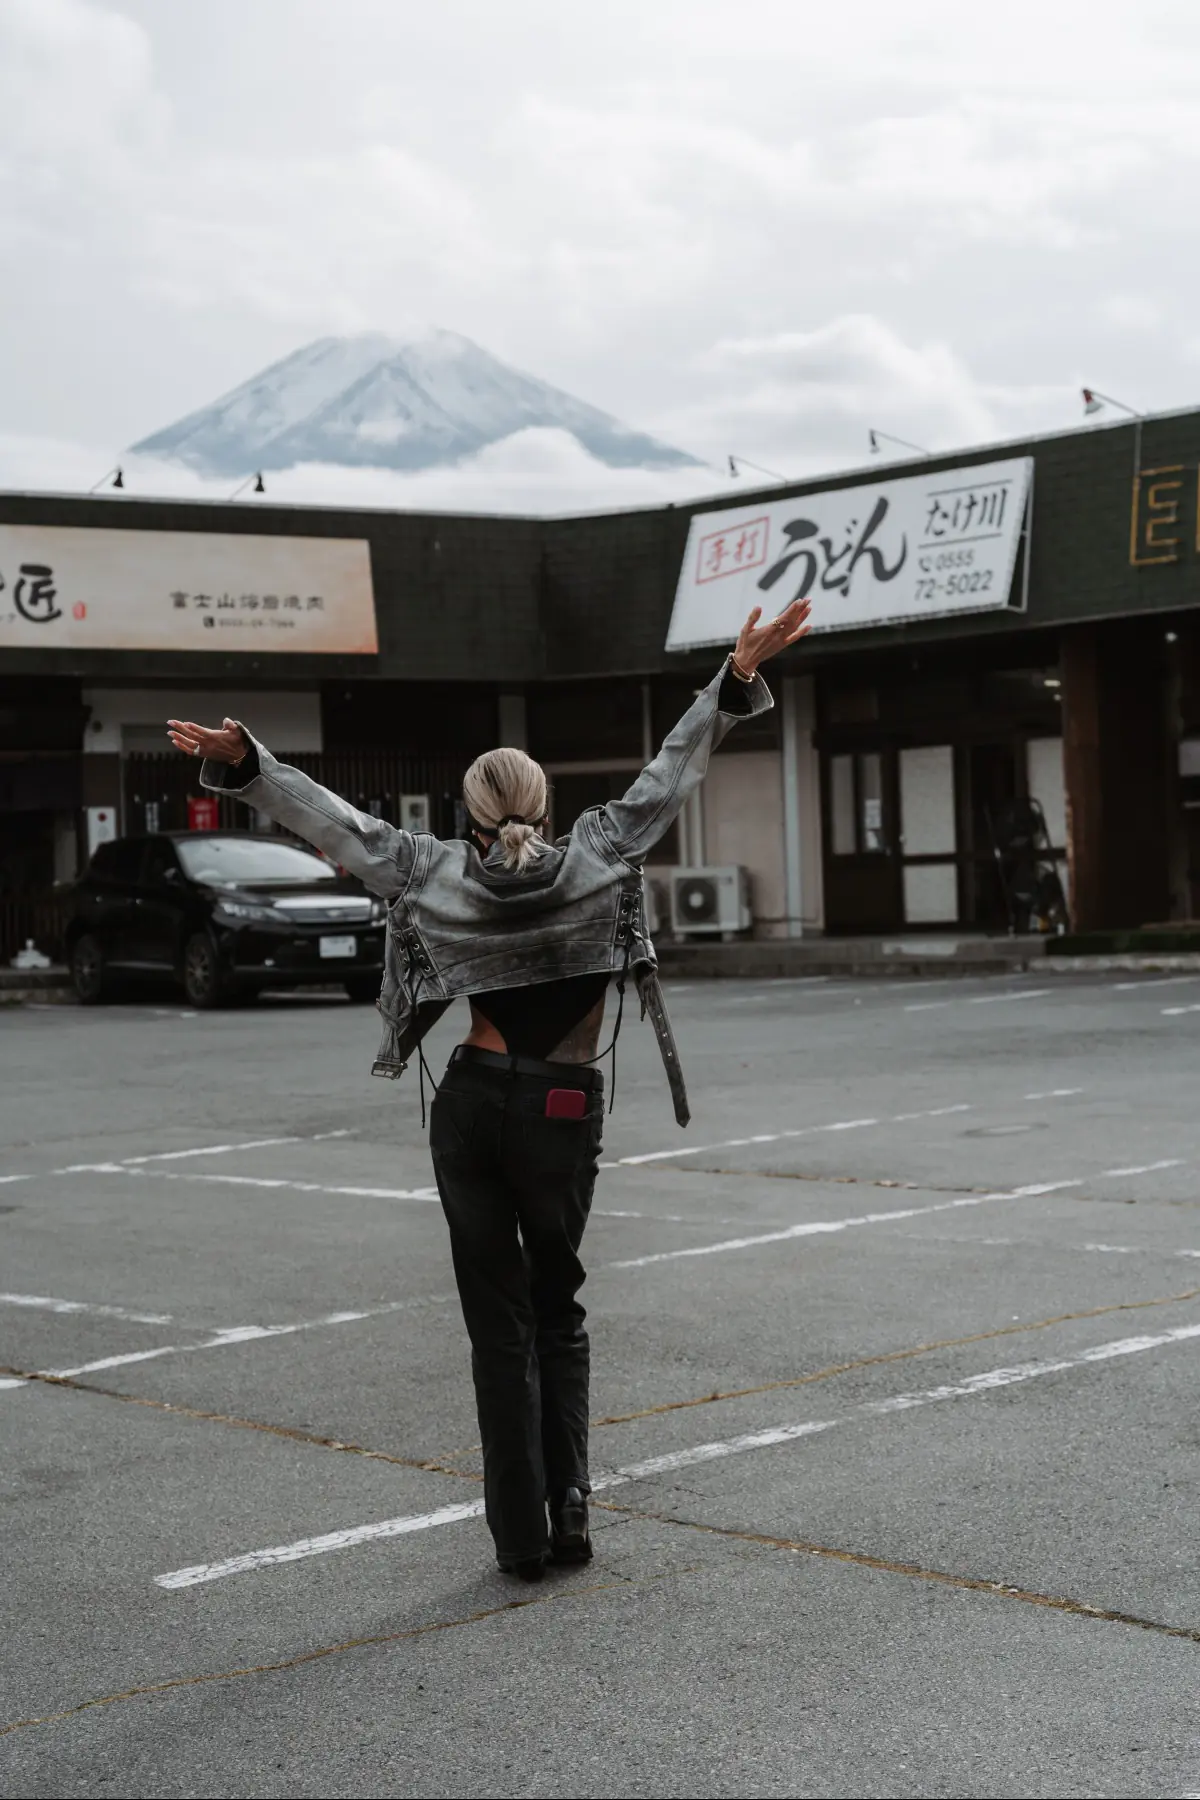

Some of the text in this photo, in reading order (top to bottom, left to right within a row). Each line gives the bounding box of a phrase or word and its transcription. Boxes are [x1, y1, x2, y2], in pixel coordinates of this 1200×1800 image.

[924, 487, 1008, 536] たけ川
[705, 529, 760, 572] 手打
[757, 496, 907, 617] うどん
[935, 549, 975, 571] 0555
[0, 564, 62, 623] 匠
[914, 569, 993, 600] 72-5022
